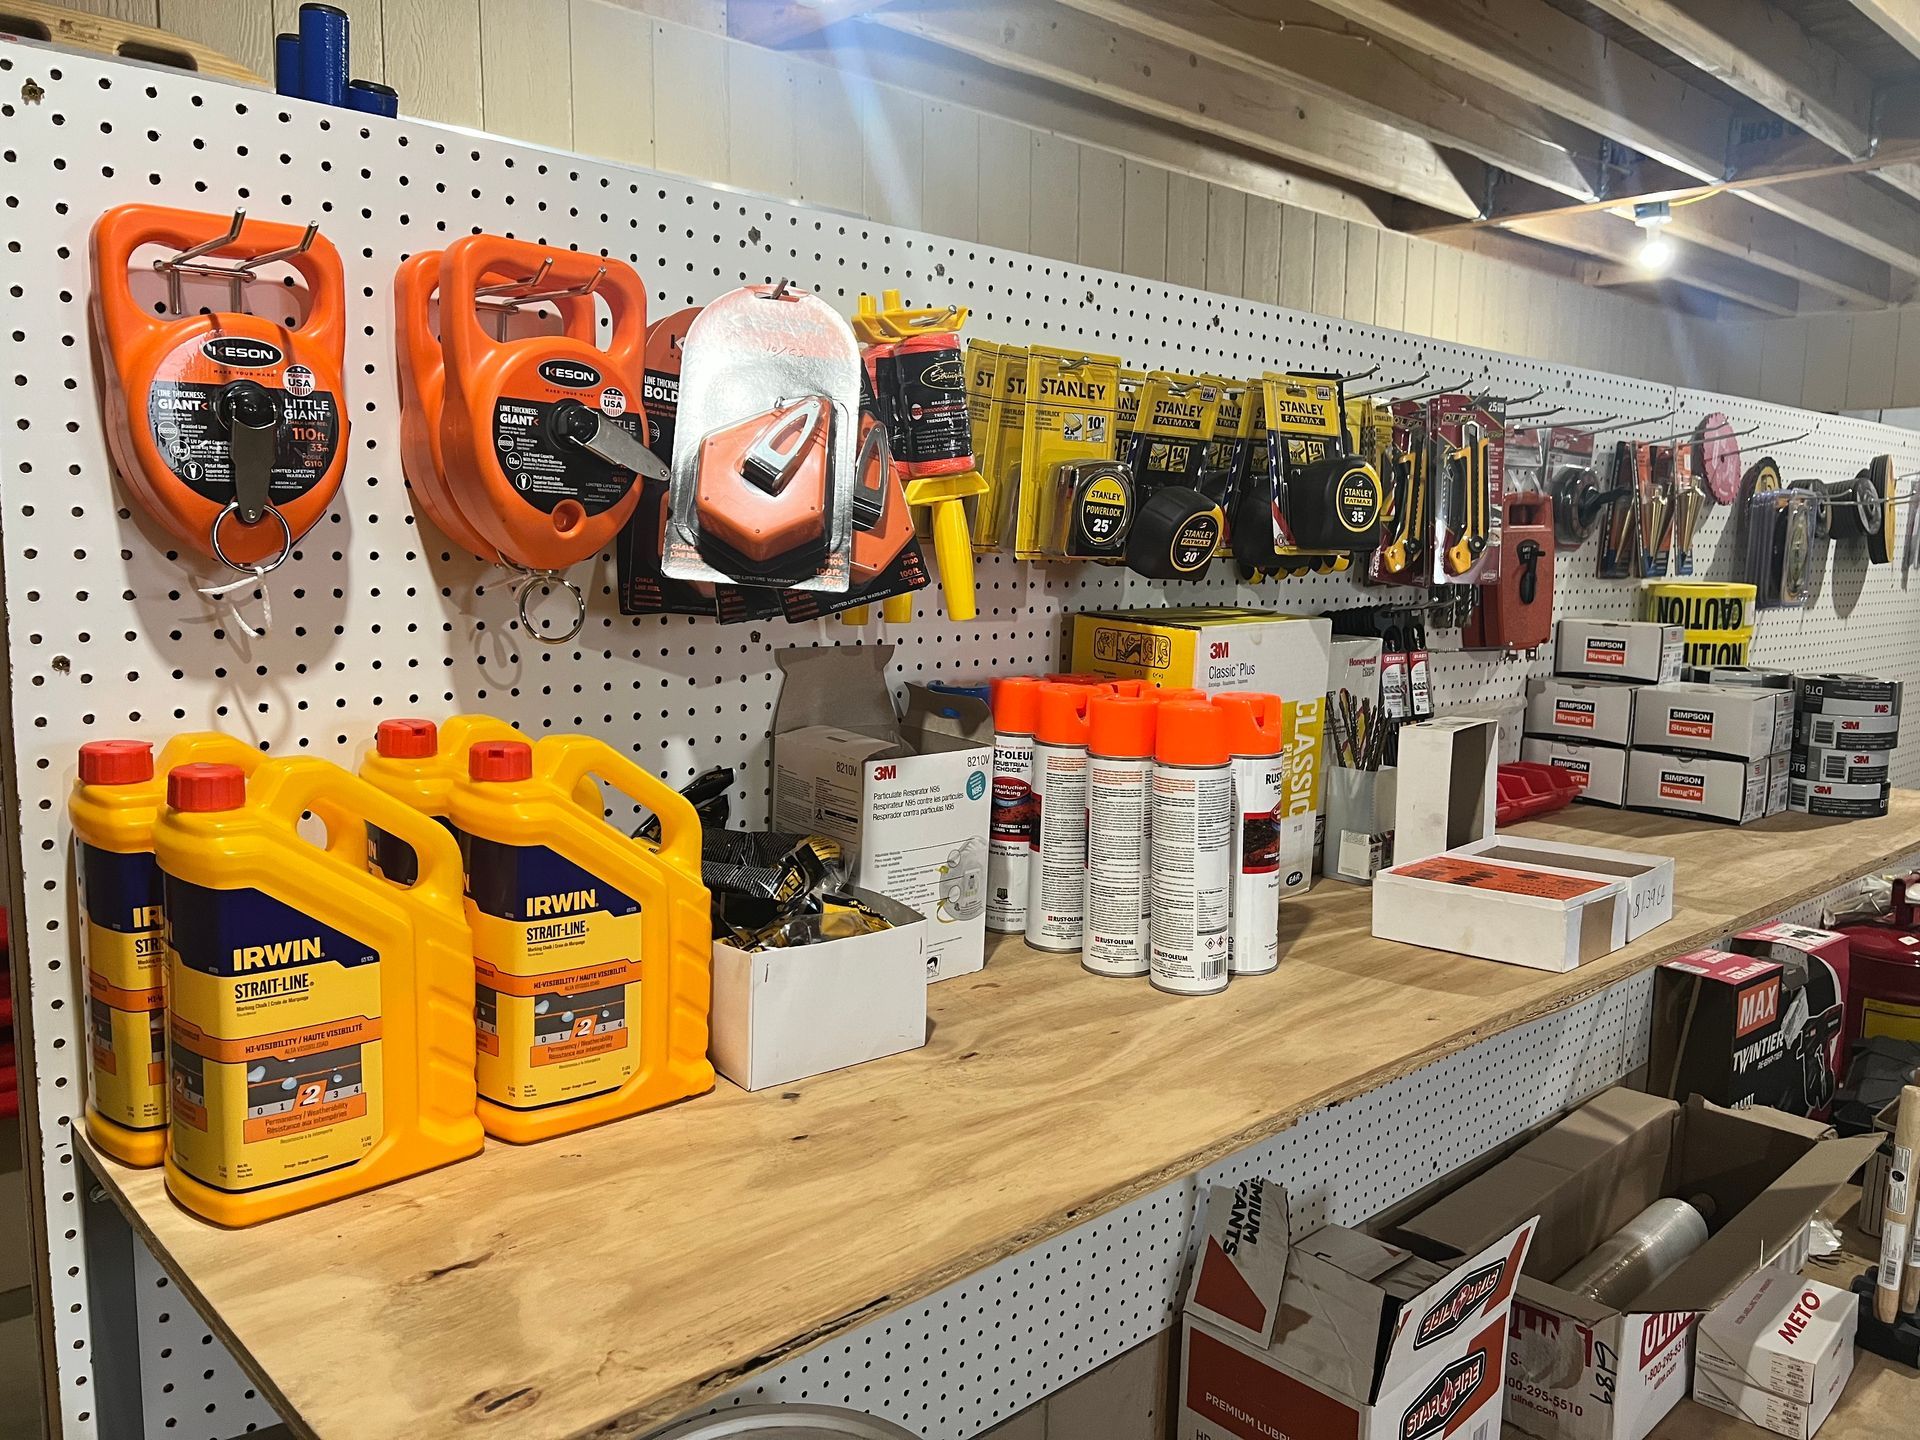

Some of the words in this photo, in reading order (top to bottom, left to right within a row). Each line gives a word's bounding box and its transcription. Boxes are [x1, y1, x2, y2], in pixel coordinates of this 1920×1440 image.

[212, 346, 274, 360] KESON
[546, 366, 594, 382] KESON
[644, 375, 655, 385] LINE
[288, 378, 311, 388] USA
[1040, 378, 1106, 400] STANLEY
[173, 390, 206, 399] THICKNESS:
[644, 387, 679, 403] BOLD
[158, 399, 201, 411] GIANT
[285, 398, 329, 411] LITTLE
[604, 400, 622, 409] USA
[1155, 400, 1204, 418] STANLEY
[1280, 401, 1324, 416] STANLEY
[1488, 402, 1498, 412] 25
[284, 409, 325, 420] GIANT
[500, 413, 534, 426] GIANT
[1285, 415, 1320, 425] FATMAX
[1088, 416, 1105, 429] 10'
[1157, 416, 1195, 428] FATMAX
[292, 428, 328, 441] 110ft.
[1064, 427, 1075, 436] 2x
[310, 444, 329, 452] 33m
[1091, 491, 1121, 501] STANLEY
[1344, 488, 1373, 498] STANLEY
[1345, 497, 1372, 505] FATMAX
[1086, 505, 1121, 517] POWERLOCK
[1351, 510, 1366, 523] 35'
[1093, 518, 1112, 533] 25'
[1183, 529, 1214, 540] STANLEY
[1183, 551, 1200, 563] 30'
[900, 568, 922, 578] 100ft.
[908, 577, 926, 586] 30m
[830, 601, 847, 610] LIMITED
[1657, 596, 1743, 630] CAUTION
[1209, 642, 1229, 660] 3M
[1590, 641, 1623, 649] SIMPSON
[1349, 656, 1376, 667] Honeywell
[1208, 665, 1236, 680] Classic
[1240, 663, 1256, 676] Plus
[1805, 684, 1823, 695] DT8
[1559, 702, 1592, 711] SIMPSON
[1874, 704, 1888, 713] 3M
[1673, 710, 1710, 721] SIMPSON
[1841, 721, 1860, 730] 3M
[967, 754, 990, 767] 8210V
[1283, 743, 1293, 781] PLUS
[1288, 700, 1318, 818] CLASSIC
[1554, 759, 1587, 770] SIMPSON
[1854, 755, 1869, 764] 3M
[836, 761, 858, 778] 8210V
[874, 765, 897, 781] 3M
[1664, 773, 1701, 784] SIMPSON
[873, 790, 902, 800] Particulate
[903, 787, 928, 797] Respirator
[929, 785, 940, 793] N95
[972, 785, 982, 796] N95
[994, 788, 1021, 796] Marking
[1814, 785, 1832, 795] 3M
[873, 801, 904, 811] Respirateur
[905, 798, 916, 807] N95
[917, 797, 932, 806] contre
[942, 792, 964, 803] particules
[872, 811, 902, 821] Respirador
[903, 808, 920, 818] contra
[945, 803, 954, 811] N95
[526, 888, 596, 917] IRWIN
[526, 920, 586, 942] STRAIT-LINE
[1100, 937, 1134, 945] RUST-OLEUM
[234, 936, 321, 971] IRWIN
[533, 976, 575, 989] HI-VISIBILITY
[579, 972, 597, 981] HAUTE
[598, 966, 627, 978] VISIBILITÉ
[235, 973, 309, 1000] STRAIT-LINE
[1740, 984, 1777, 1030] MAX
[575, 1019, 592, 1038] 2
[602, 1024, 606, 1032] 3
[245, 1038, 297, 1054] HI-VISIBILITY
[303, 1032, 325, 1042] HAUTE
[326, 1023, 362, 1038] VISIBILITÉ
[1733, 1030, 1784, 1074] TWINTIER
[257, 1106, 263, 1115] 0
[280, 1103, 284, 1111] 1
[300, 1085, 321, 1107] 2
[333, 1090, 338, 1098] 3
[354, 1085, 359, 1093] 4
[265, 1112, 302, 1126] Permanency
[307, 1103, 348, 1118] Weatherability
[1466, 1268, 1500, 1305] STAR
[1421, 1308, 1452, 1339] FIRE
[1777, 1291, 1821, 1345] METO
[1644, 1334, 1689, 1386] 1-800-295-5510
[1654, 1362, 1677, 1390] uline.com
[1406, 1394, 1440, 1438] STAR
[1450, 1359, 1481, 1398] FIRE
[1205, 1392, 1254, 1427] PREMIUM
[1511, 1392, 1559, 1420] uline.com
